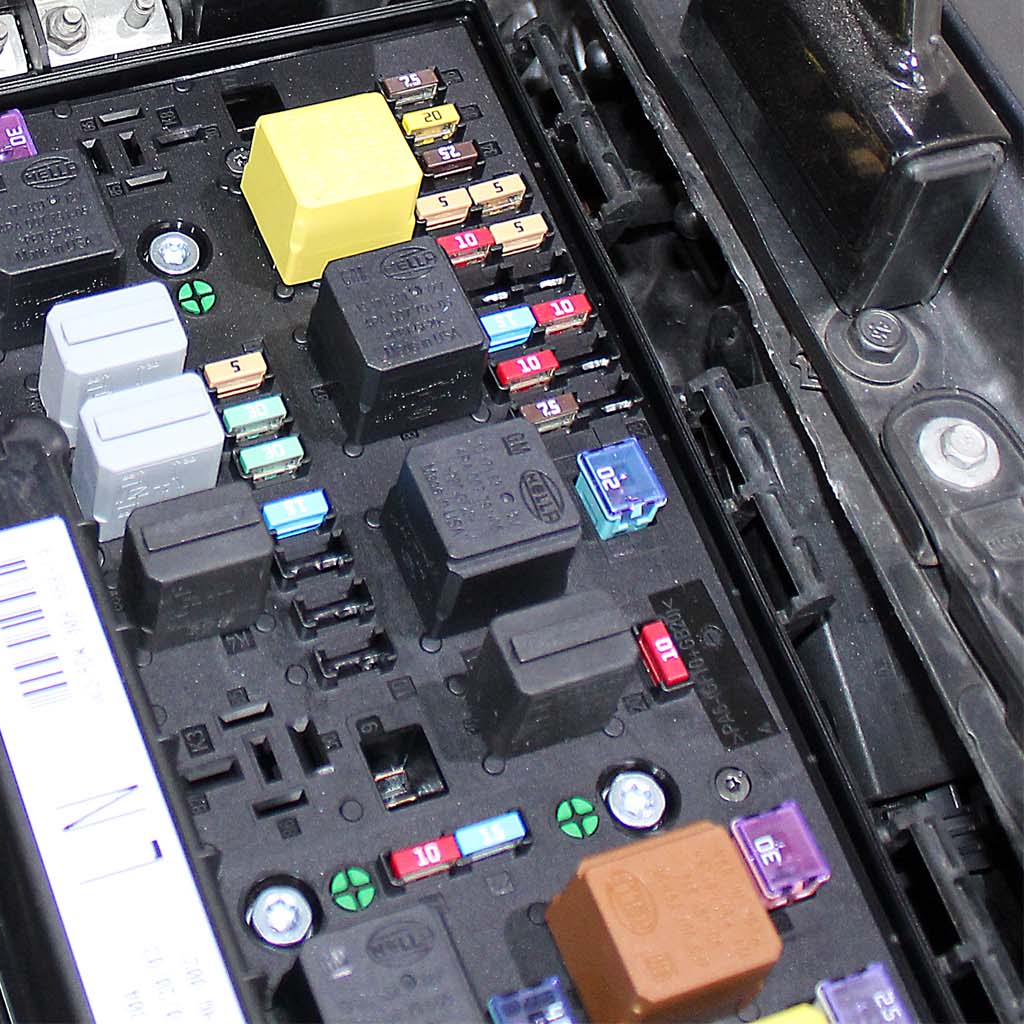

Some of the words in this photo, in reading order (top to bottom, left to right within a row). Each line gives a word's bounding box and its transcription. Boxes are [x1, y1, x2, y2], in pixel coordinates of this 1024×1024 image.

[424, 110, 442, 122] 20
[5, 127, 27, 147] 30
[493, 181, 504, 194] 5
[438, 196, 449, 208] 5
[513, 221, 524, 233] 5
[455, 232, 479, 249] 10
[550, 298, 575, 316] 10
[230, 360, 241, 373] 5
[517, 355, 542, 373] 10
[596, 466, 621, 492] 20
[655, 637, 678, 662] 10
[412, 843, 441, 867] 10
[753, 835, 782, 866] 30
[874, 989, 902, 1022] 25
